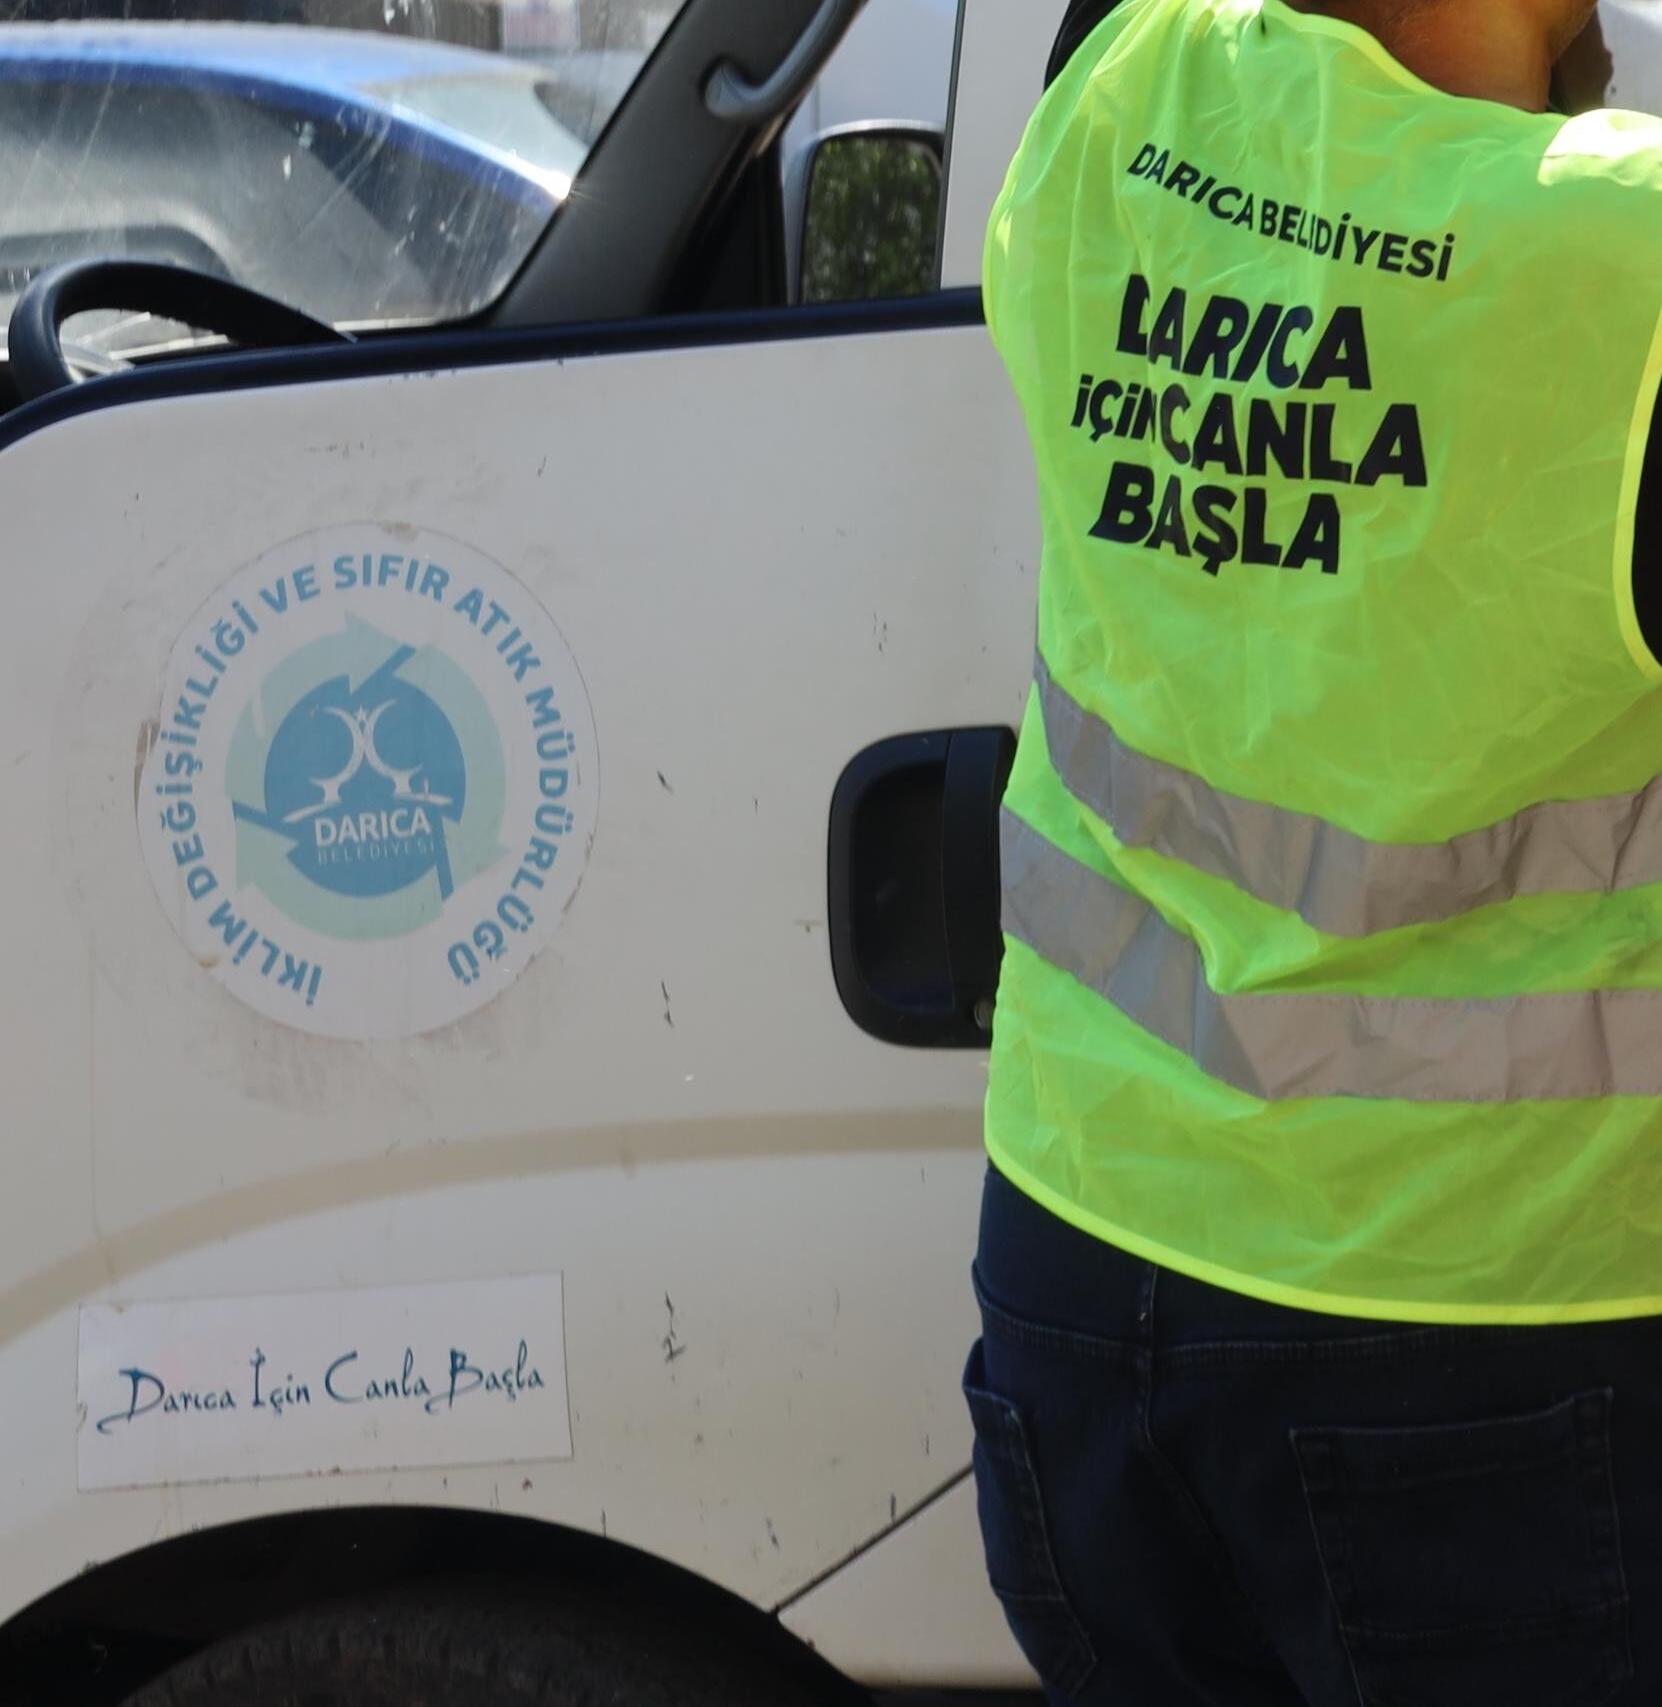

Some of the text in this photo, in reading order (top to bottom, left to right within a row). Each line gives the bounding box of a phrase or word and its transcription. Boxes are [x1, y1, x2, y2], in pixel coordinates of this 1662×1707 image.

[1127, 142, 1456, 282] DARICA BELDİYESİ
[1160, 382, 1428, 487] CANLA
[1087, 460, 1341, 577] BAŞLA
[156, 554, 576, 1007] İKLİM DEĞİŞİKLİĞİ VE SIFIR ATIK MÜDÜRLÜĞÜ
[315, 806, 432, 846] DARICA
[250, 1347, 310, 1414] İçin
[324, 1346, 430, 1403] Canla
[424, 1339, 545, 1414] Başla
